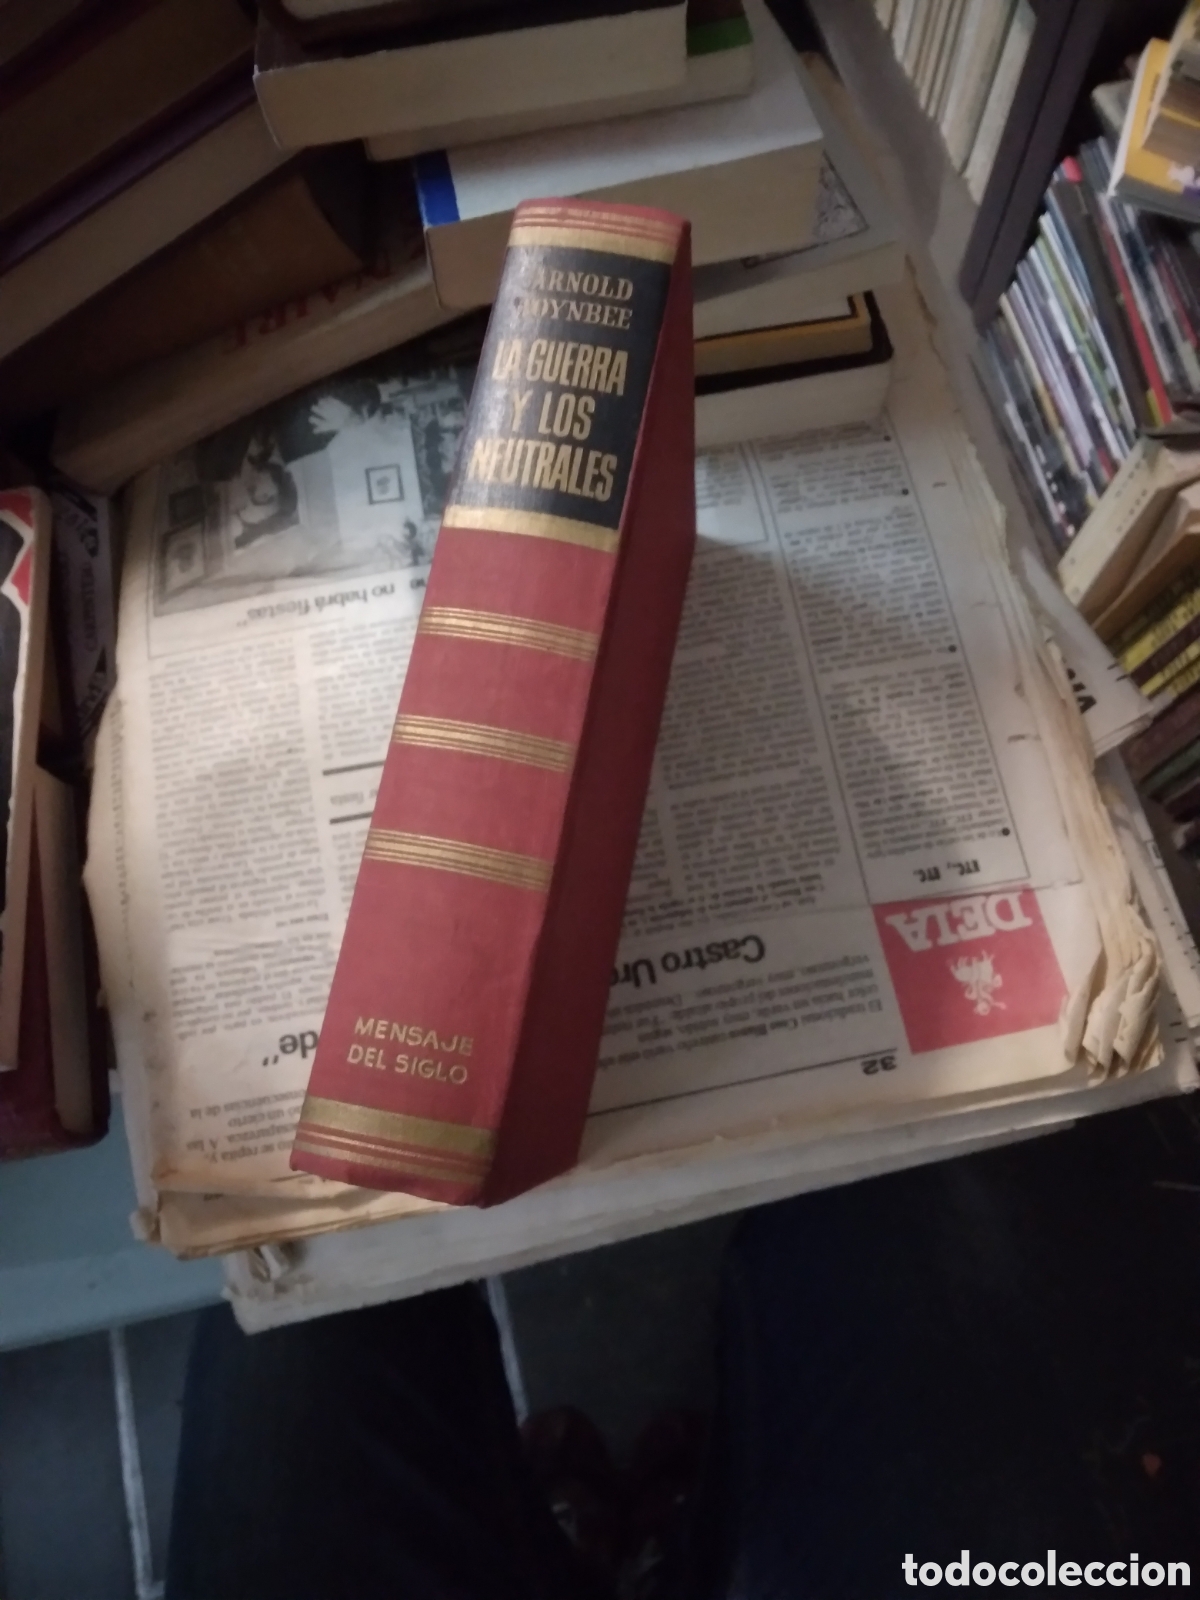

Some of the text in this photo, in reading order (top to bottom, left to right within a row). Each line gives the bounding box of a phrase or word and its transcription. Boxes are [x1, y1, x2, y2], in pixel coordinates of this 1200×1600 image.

[531, 268, 633, 300] ARNOLD
[492, 338, 628, 396] LA GUERRA
[511, 388, 596, 441] Y LOS
[467, 438, 618, 502] NEUTRALES
[314, 588, 368, 612] habrá
[885, 891, 1033, 952] DEIA
[661, 934, 765, 973] Castro
[354, 1016, 474, 1056] MENSAJE
[346, 1044, 468, 1085] DEL SIGLO
[861, 1055, 897, 1076] 32
